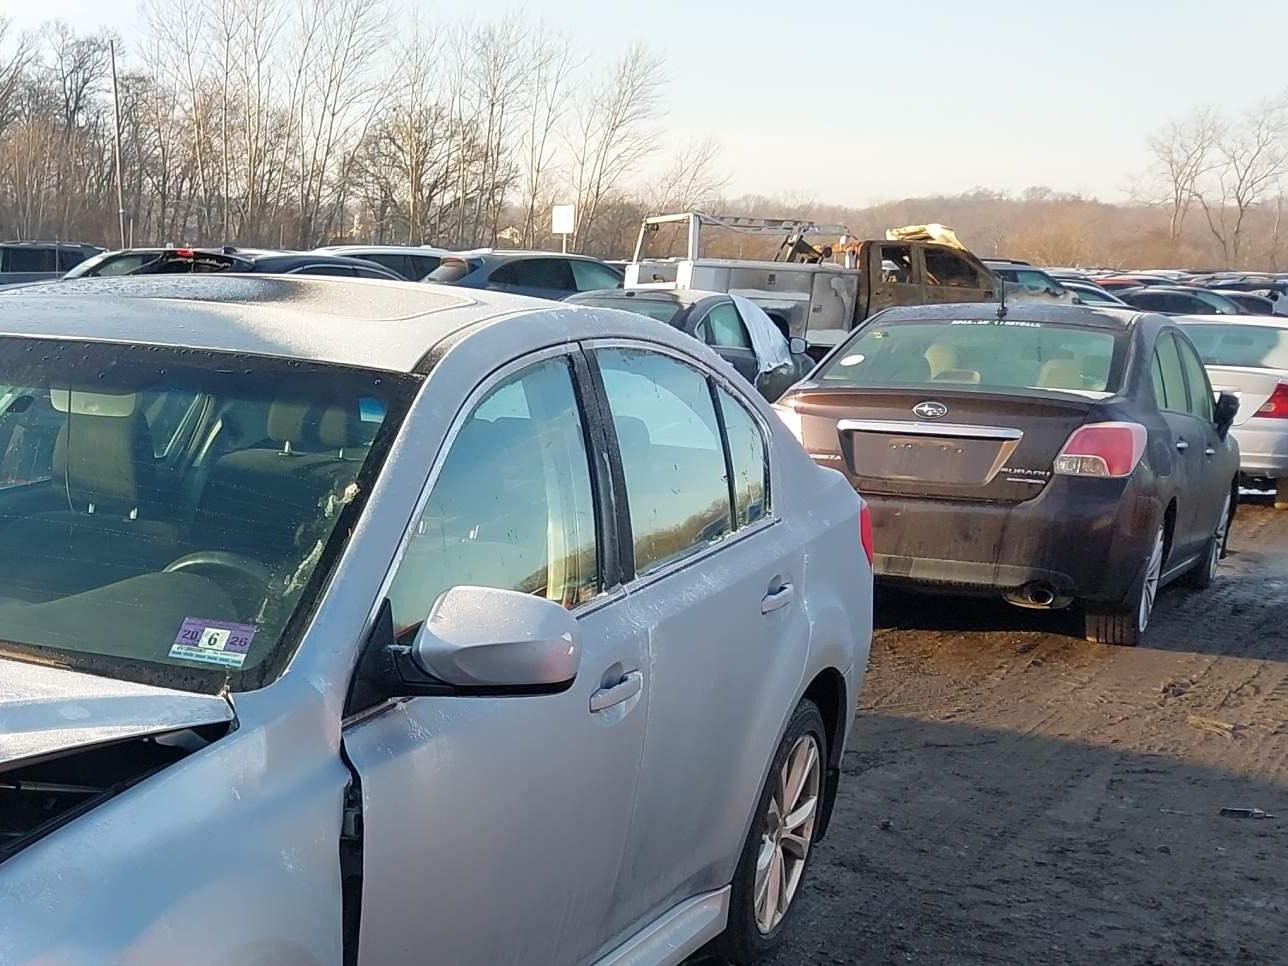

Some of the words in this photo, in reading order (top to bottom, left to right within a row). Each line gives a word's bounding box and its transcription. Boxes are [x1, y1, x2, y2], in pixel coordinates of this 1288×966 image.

[1000, 467, 1051, 476] SUBARU
[182, 629, 199, 640] 20
[207, 632, 220, 646] 6
[229, 636, 248, 647] 26
